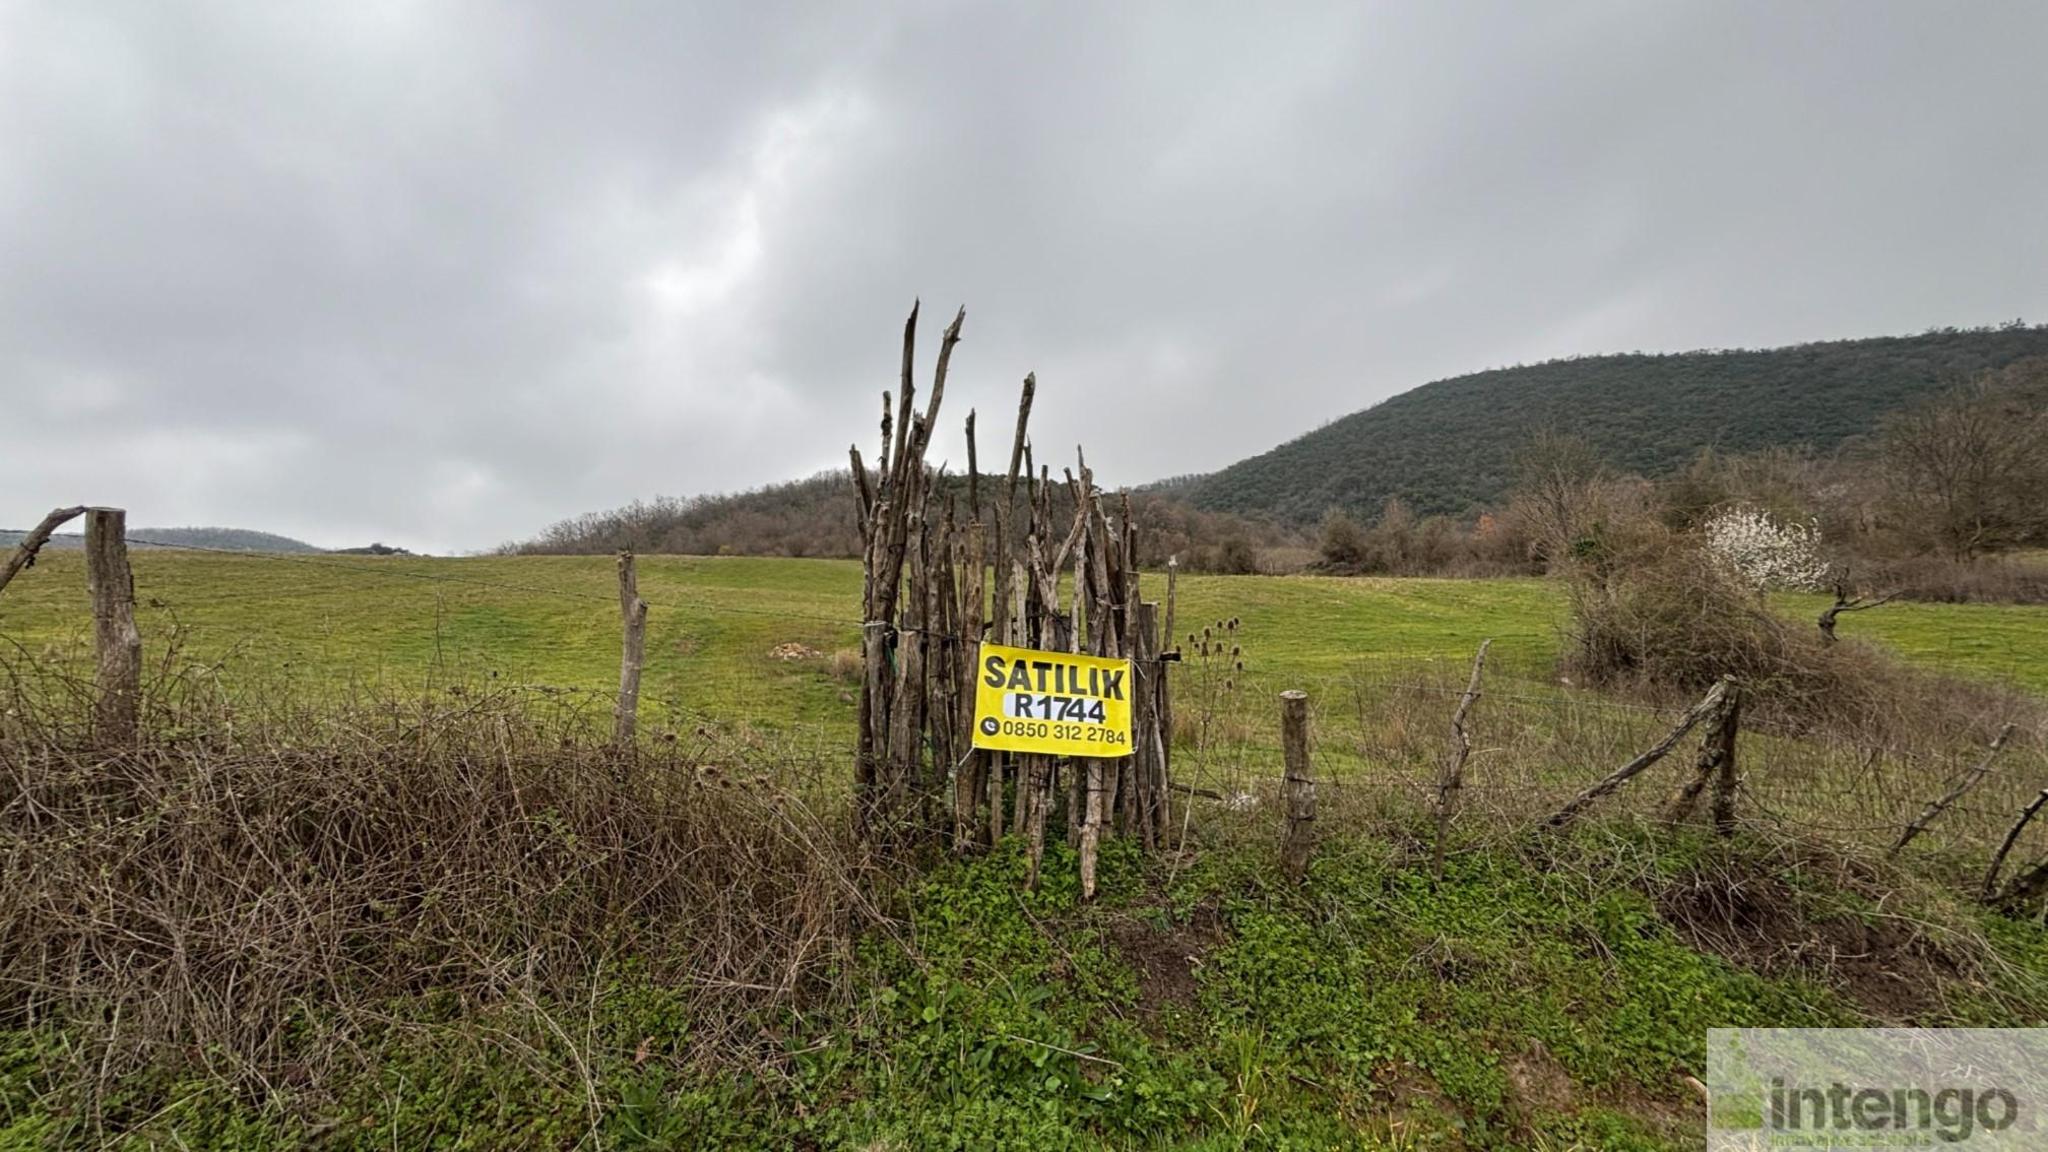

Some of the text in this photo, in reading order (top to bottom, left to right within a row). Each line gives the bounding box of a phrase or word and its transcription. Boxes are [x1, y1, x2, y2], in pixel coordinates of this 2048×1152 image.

[984, 656, 1124, 700] SATILIK
[1014, 693, 1106, 724] R1744
[1003, 720, 1126, 746] 0850 312 2784
